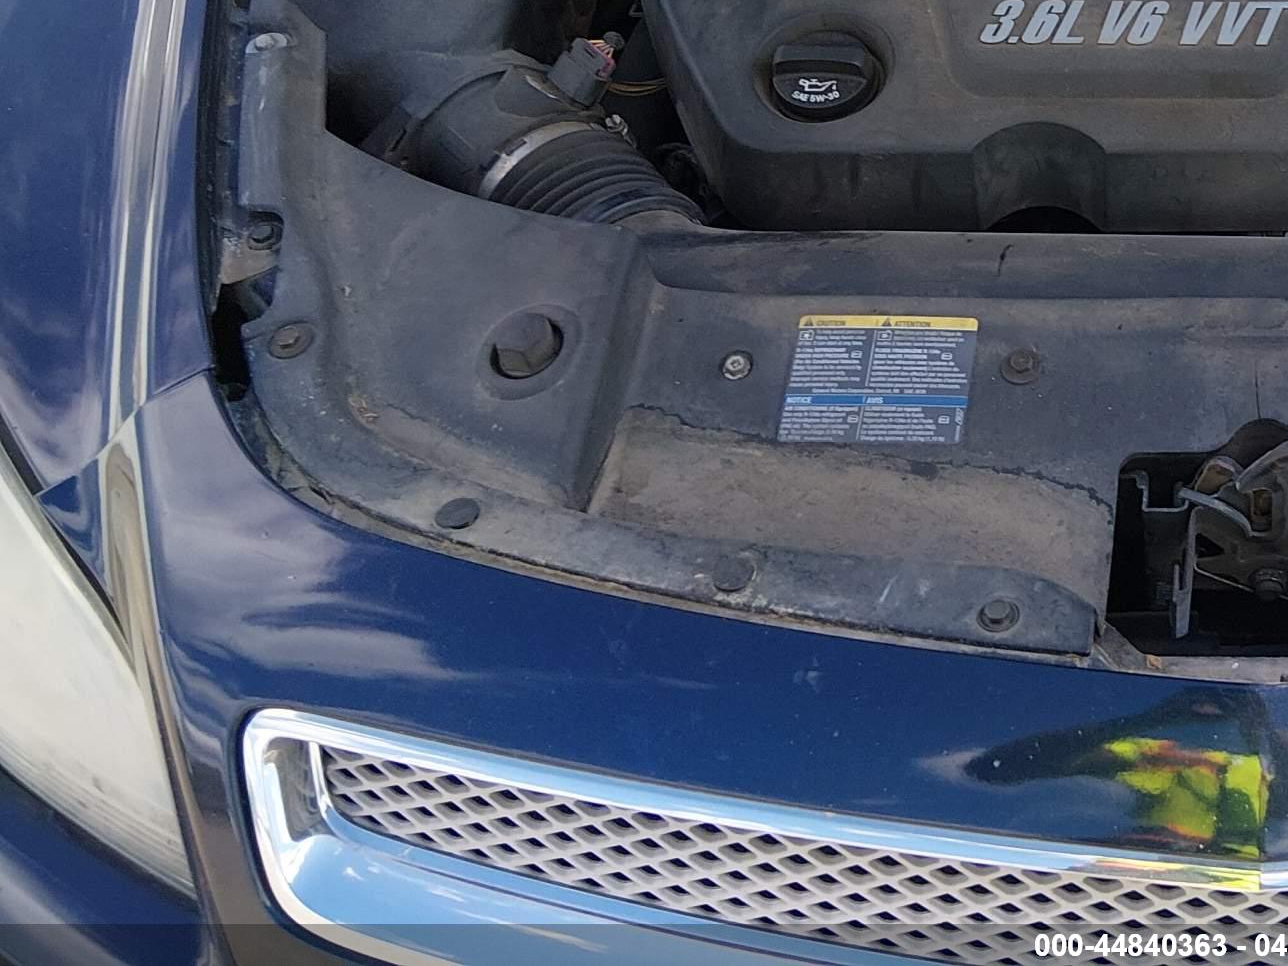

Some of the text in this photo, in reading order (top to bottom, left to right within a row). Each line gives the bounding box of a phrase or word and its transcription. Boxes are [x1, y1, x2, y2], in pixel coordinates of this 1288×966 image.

[1097, 0, 1170, 46] V6
[791, 91, 840, 103] SAE 5W-30
[785, 396, 812, 404] NOTICE
[866, 396, 884, 404] AVIS
